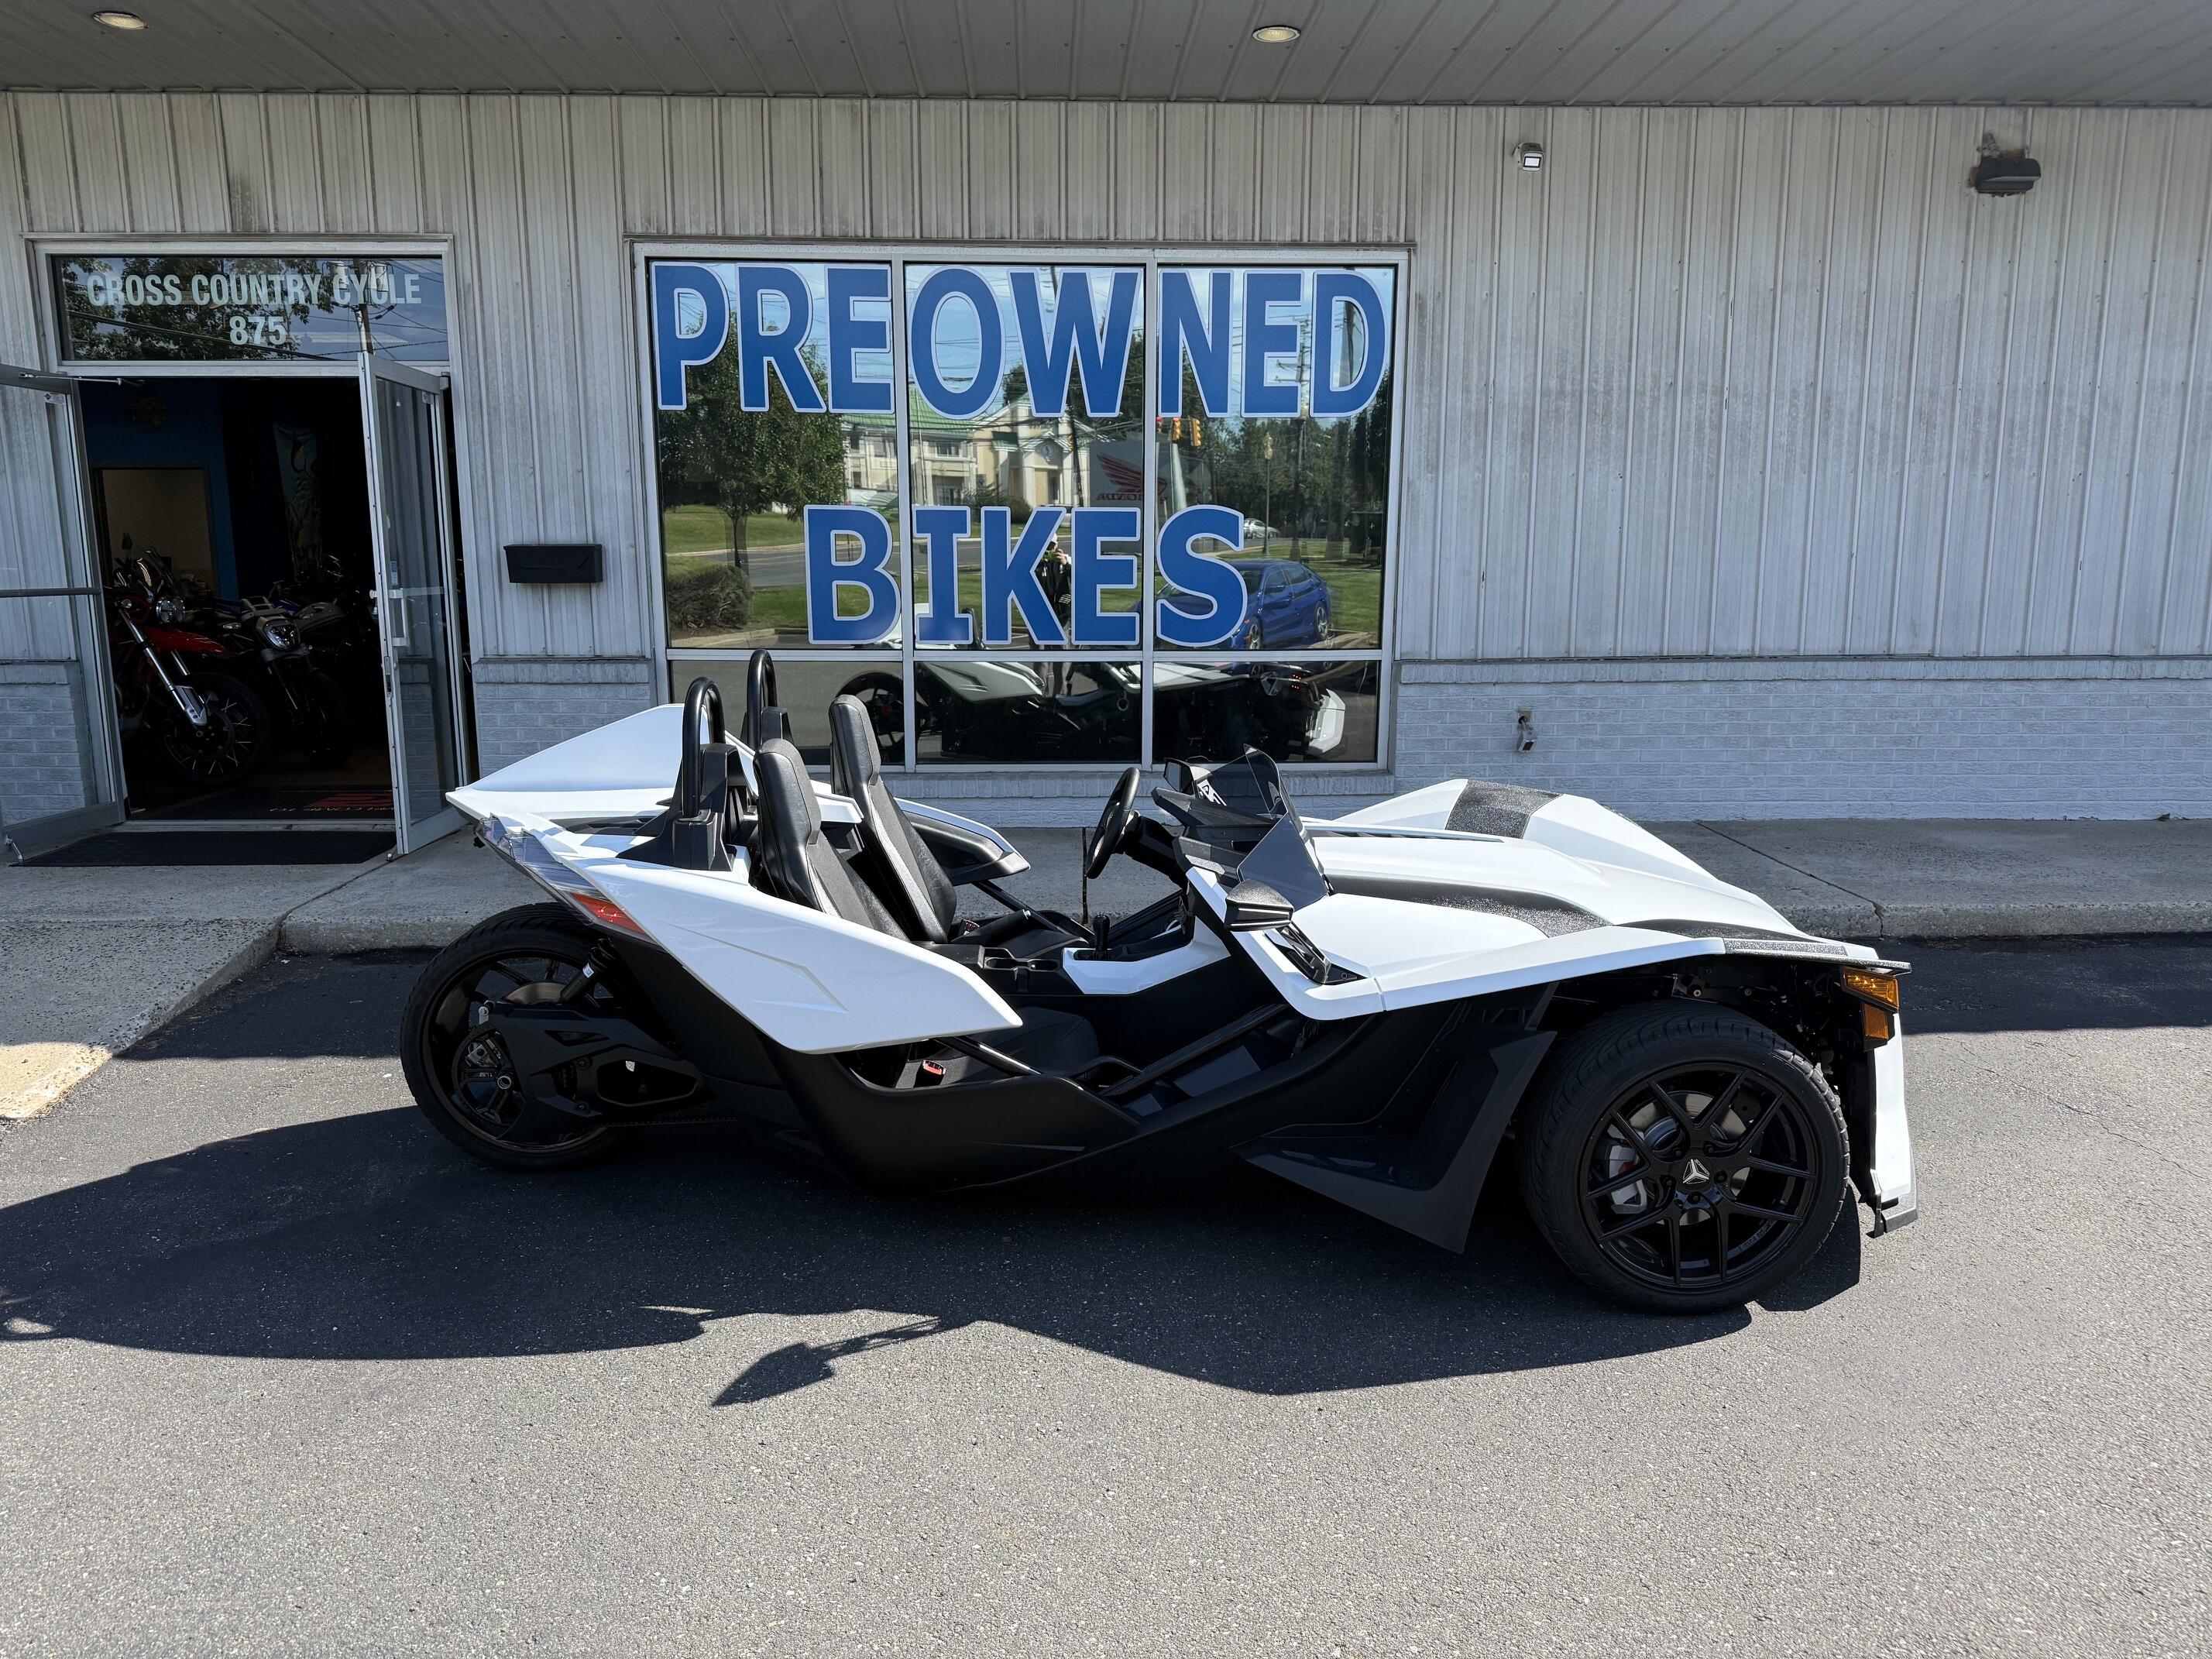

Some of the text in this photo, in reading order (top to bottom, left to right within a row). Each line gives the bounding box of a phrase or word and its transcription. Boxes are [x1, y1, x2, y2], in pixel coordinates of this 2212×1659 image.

[87, 273, 421, 306] CROSS COUNTRY CYCLE
[229, 315, 287, 345] 875
[652, 262, 1388, 419] PREOWNED
[803, 504, 1248, 647] BIKES
